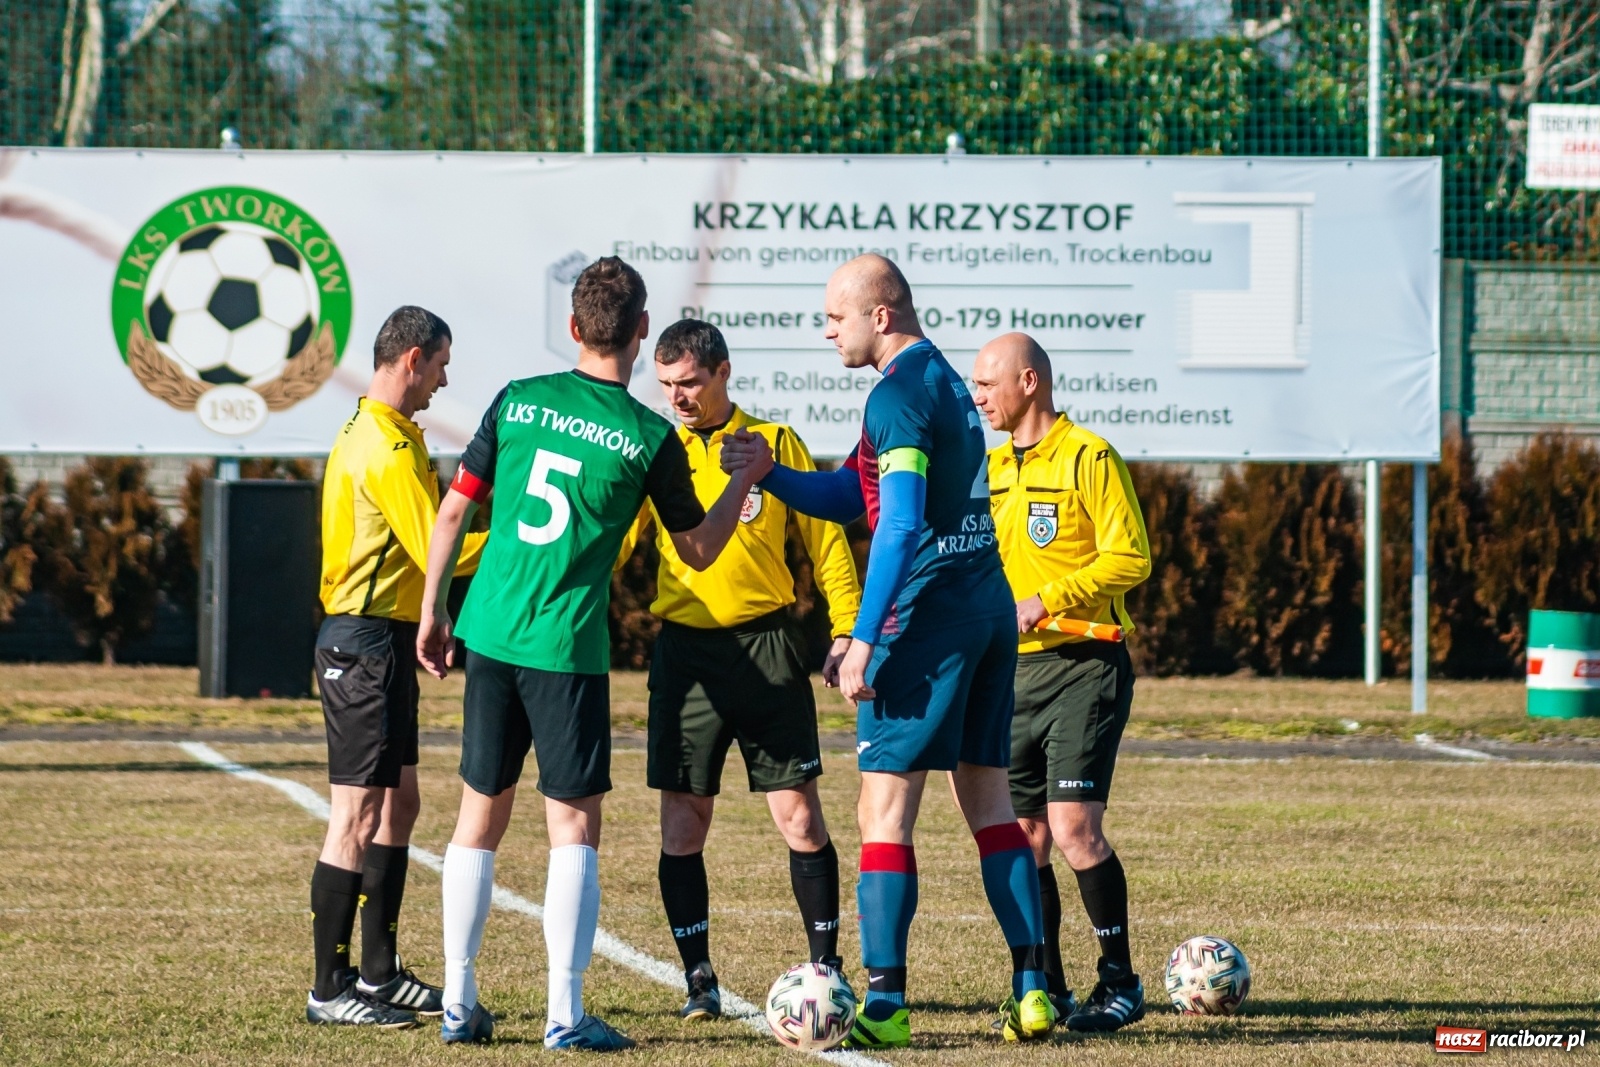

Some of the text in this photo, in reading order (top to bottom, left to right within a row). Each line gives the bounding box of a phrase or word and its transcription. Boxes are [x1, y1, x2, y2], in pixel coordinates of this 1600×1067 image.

[693, 202, 1135, 231] KRZYKAŁA KRZYSZTOF
[119, 193, 347, 293] LKS TWORKÓW
[613, 241, 1213, 268] Einbau von genormten Fertigteilen, Trockenbau
[1011, 307, 1146, 329] Hannover
[1053, 373, 1157, 392] Markisen
[209, 399, 258, 422] 1905
[505, 402, 538, 424] LKS
[540, 406, 644, 461] TWORKÓW
[517, 447, 583, 546] 5
[961, 514, 978, 532] KS
